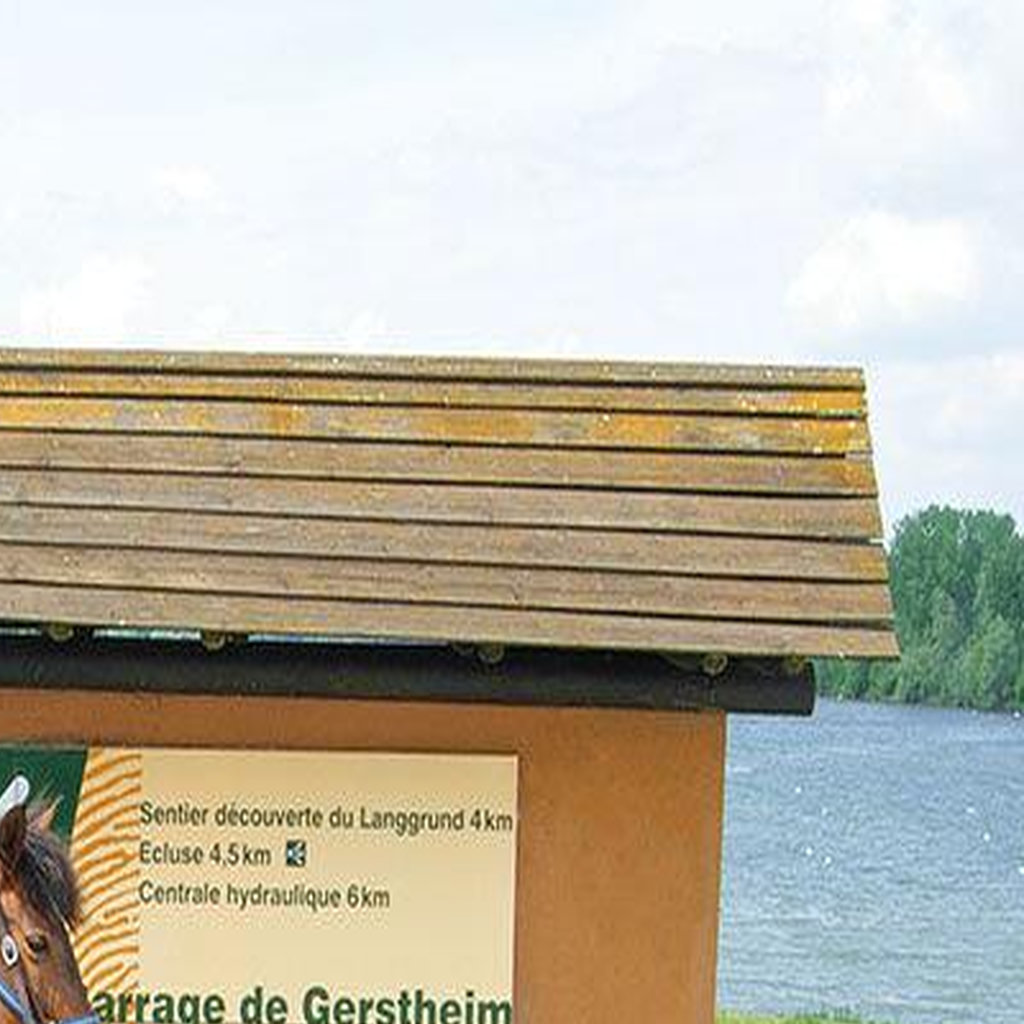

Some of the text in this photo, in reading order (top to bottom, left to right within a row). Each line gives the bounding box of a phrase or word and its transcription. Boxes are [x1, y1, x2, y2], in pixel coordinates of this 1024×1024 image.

[139, 801, 208, 826] Sentier
[214, 803, 323, 828] découverte
[328, 806, 354, 829] du
[359, 806, 465, 837] Langgrund
[139, 840, 204, 865] Ecluse
[139, 879, 222, 904] Centrale
[226, 883, 342, 911] hydraulique
